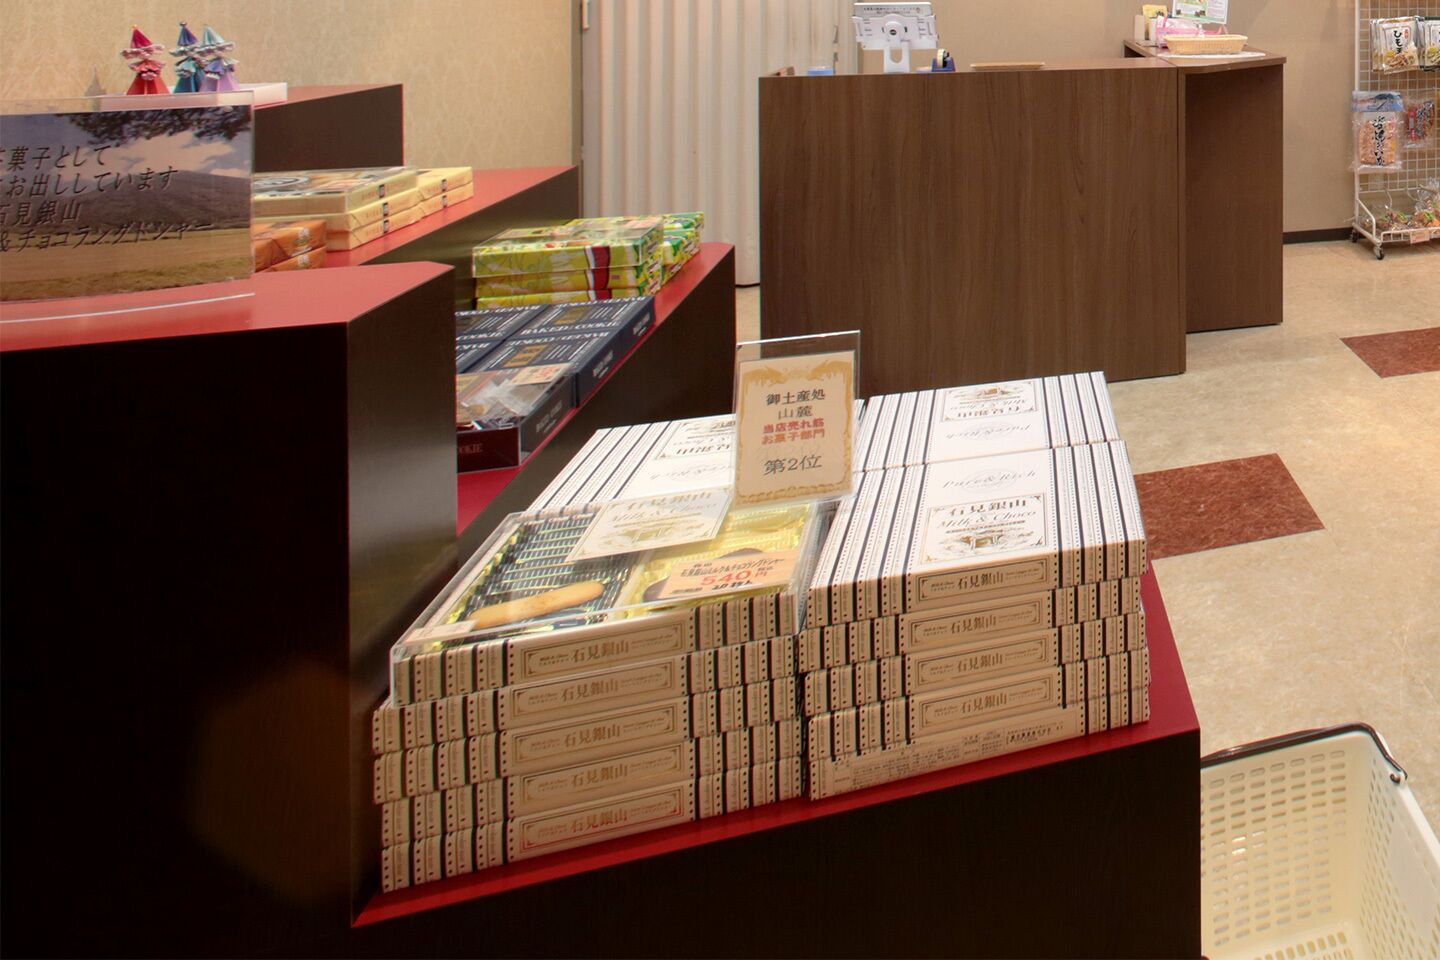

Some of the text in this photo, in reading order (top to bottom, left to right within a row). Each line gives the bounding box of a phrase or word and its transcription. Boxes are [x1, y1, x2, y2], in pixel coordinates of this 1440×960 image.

[766, 389, 826, 406] 御土産処
[777, 405, 814, 421] 山麓
[763, 418, 825, 434] 当店売れ筋
[761, 428, 826, 445] お菓子部門
[763, 454, 823, 477] 第2位
[958, 571, 1005, 590] 石見銀山
[951, 614, 998, 634] 石見銀山
[572, 640, 630, 663] 石見銀山
[957, 651, 1004, 673] 石見銀山
[561, 678, 620, 702] 石見銀山
[563, 723, 621, 748] 石見銀山
